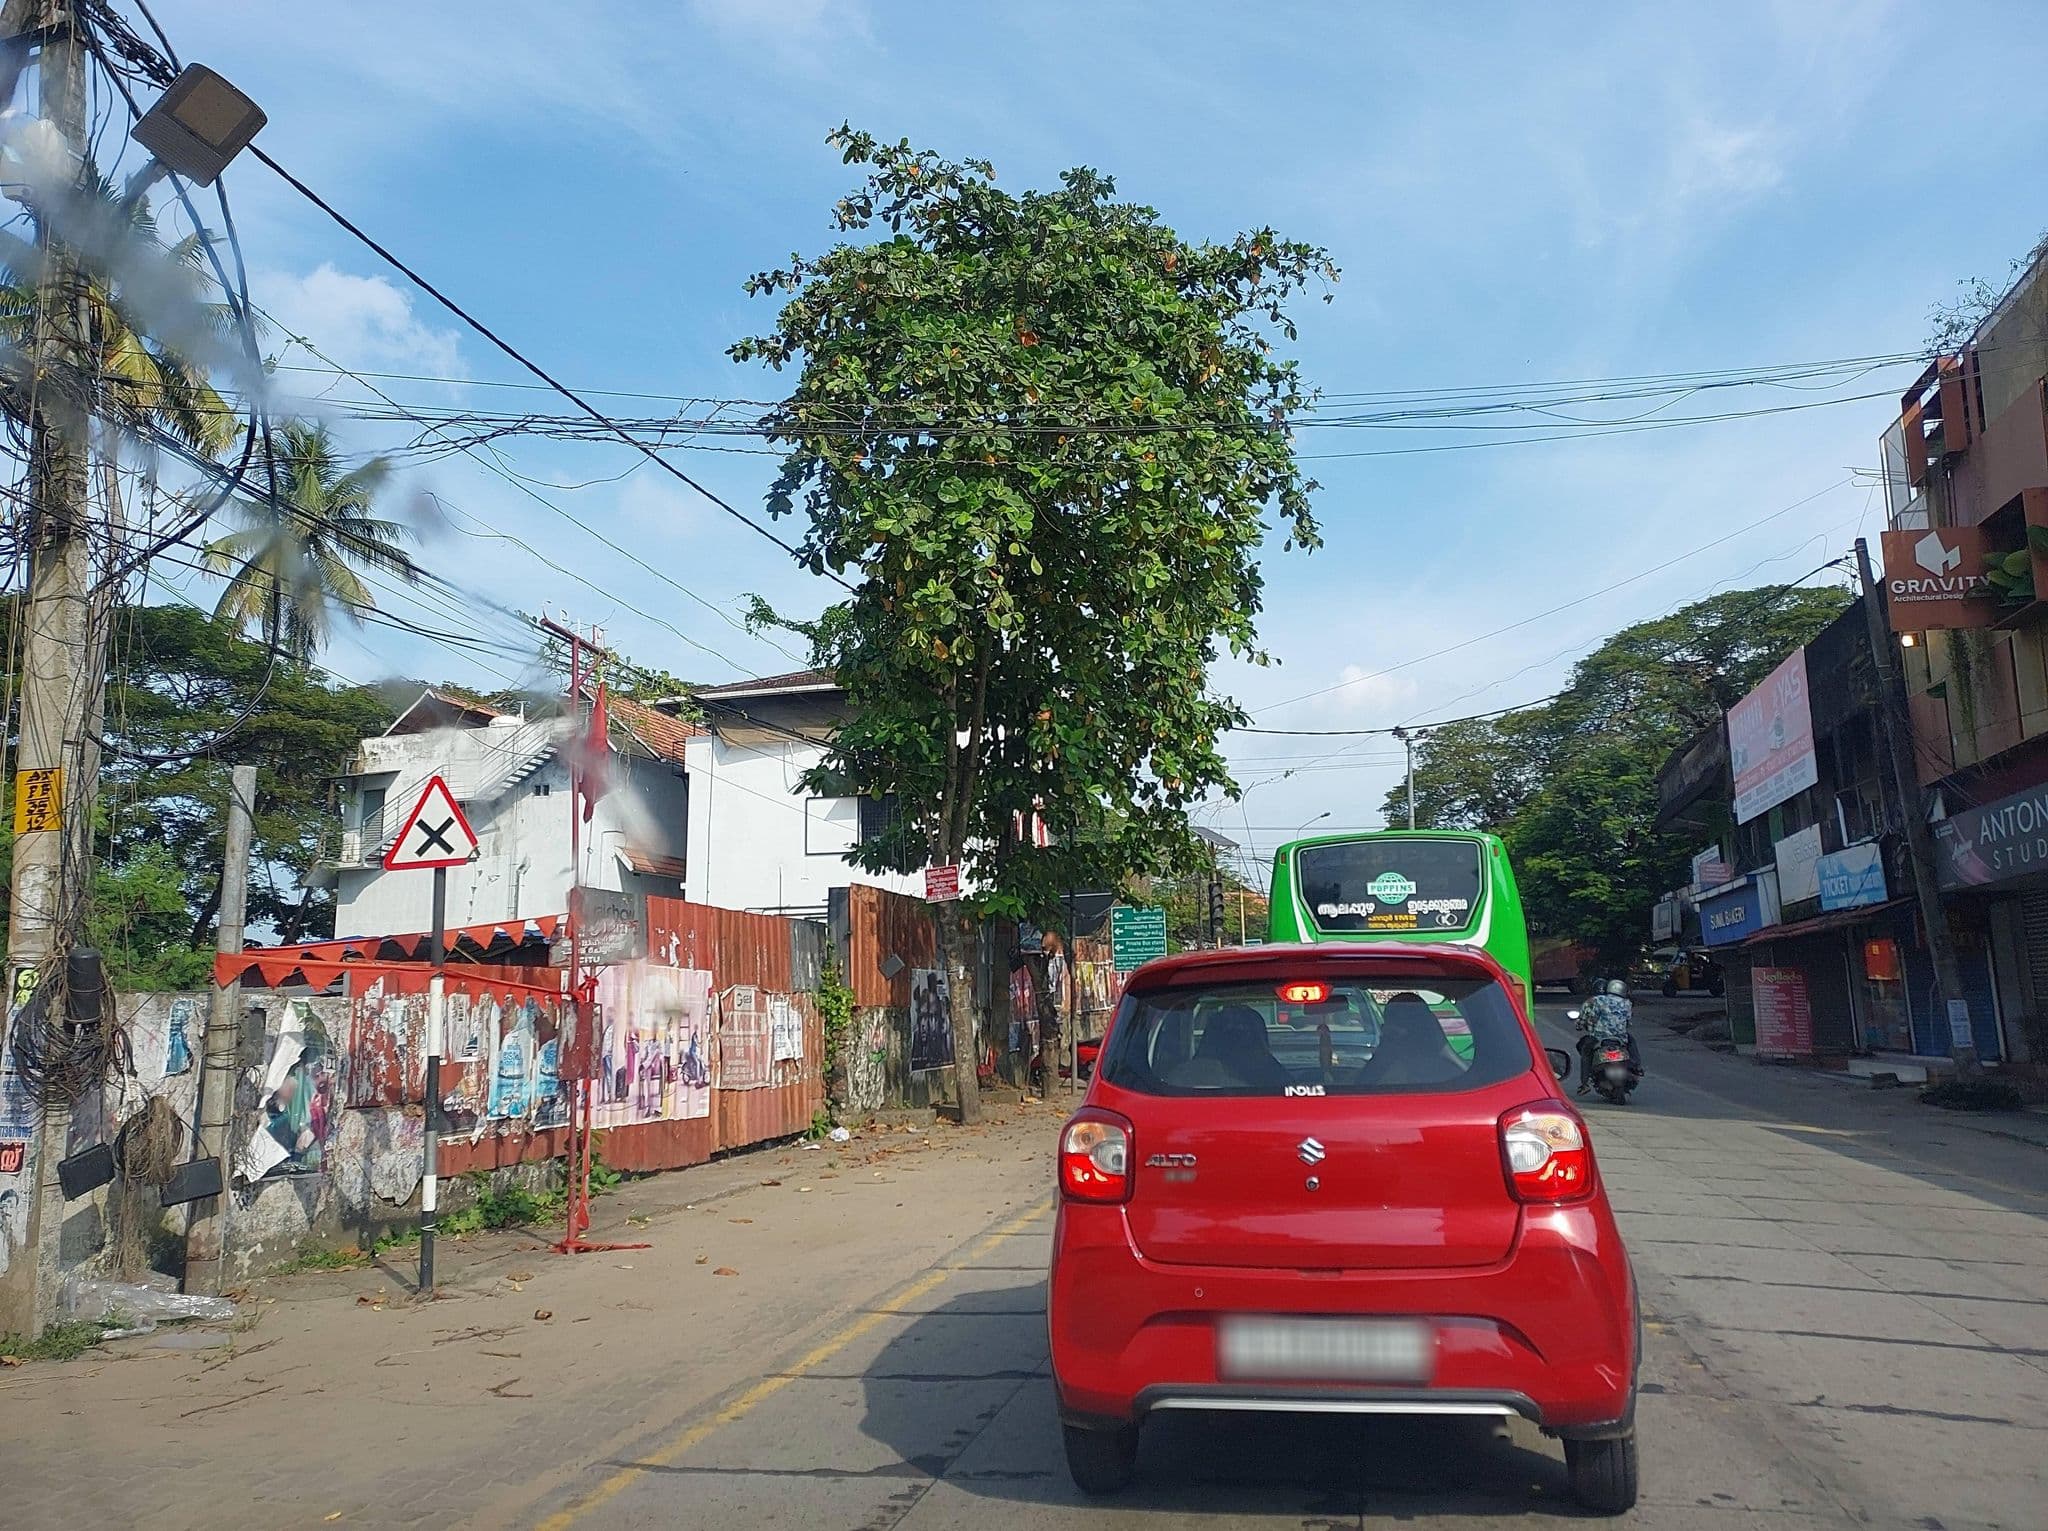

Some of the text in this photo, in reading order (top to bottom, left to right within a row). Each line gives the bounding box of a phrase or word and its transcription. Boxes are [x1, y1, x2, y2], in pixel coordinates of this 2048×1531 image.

[1894, 593, 1942, 602] Architectural
[1370, 885, 1413, 893] POPPINS
[1823, 875, 1849, 897] TICKET
[1317, 902, 1376, 918] ആലപ്പുഴ
[1284, 1085, 1326, 1097] INDUS
[1145, 1153, 1197, 1168] ALTO
